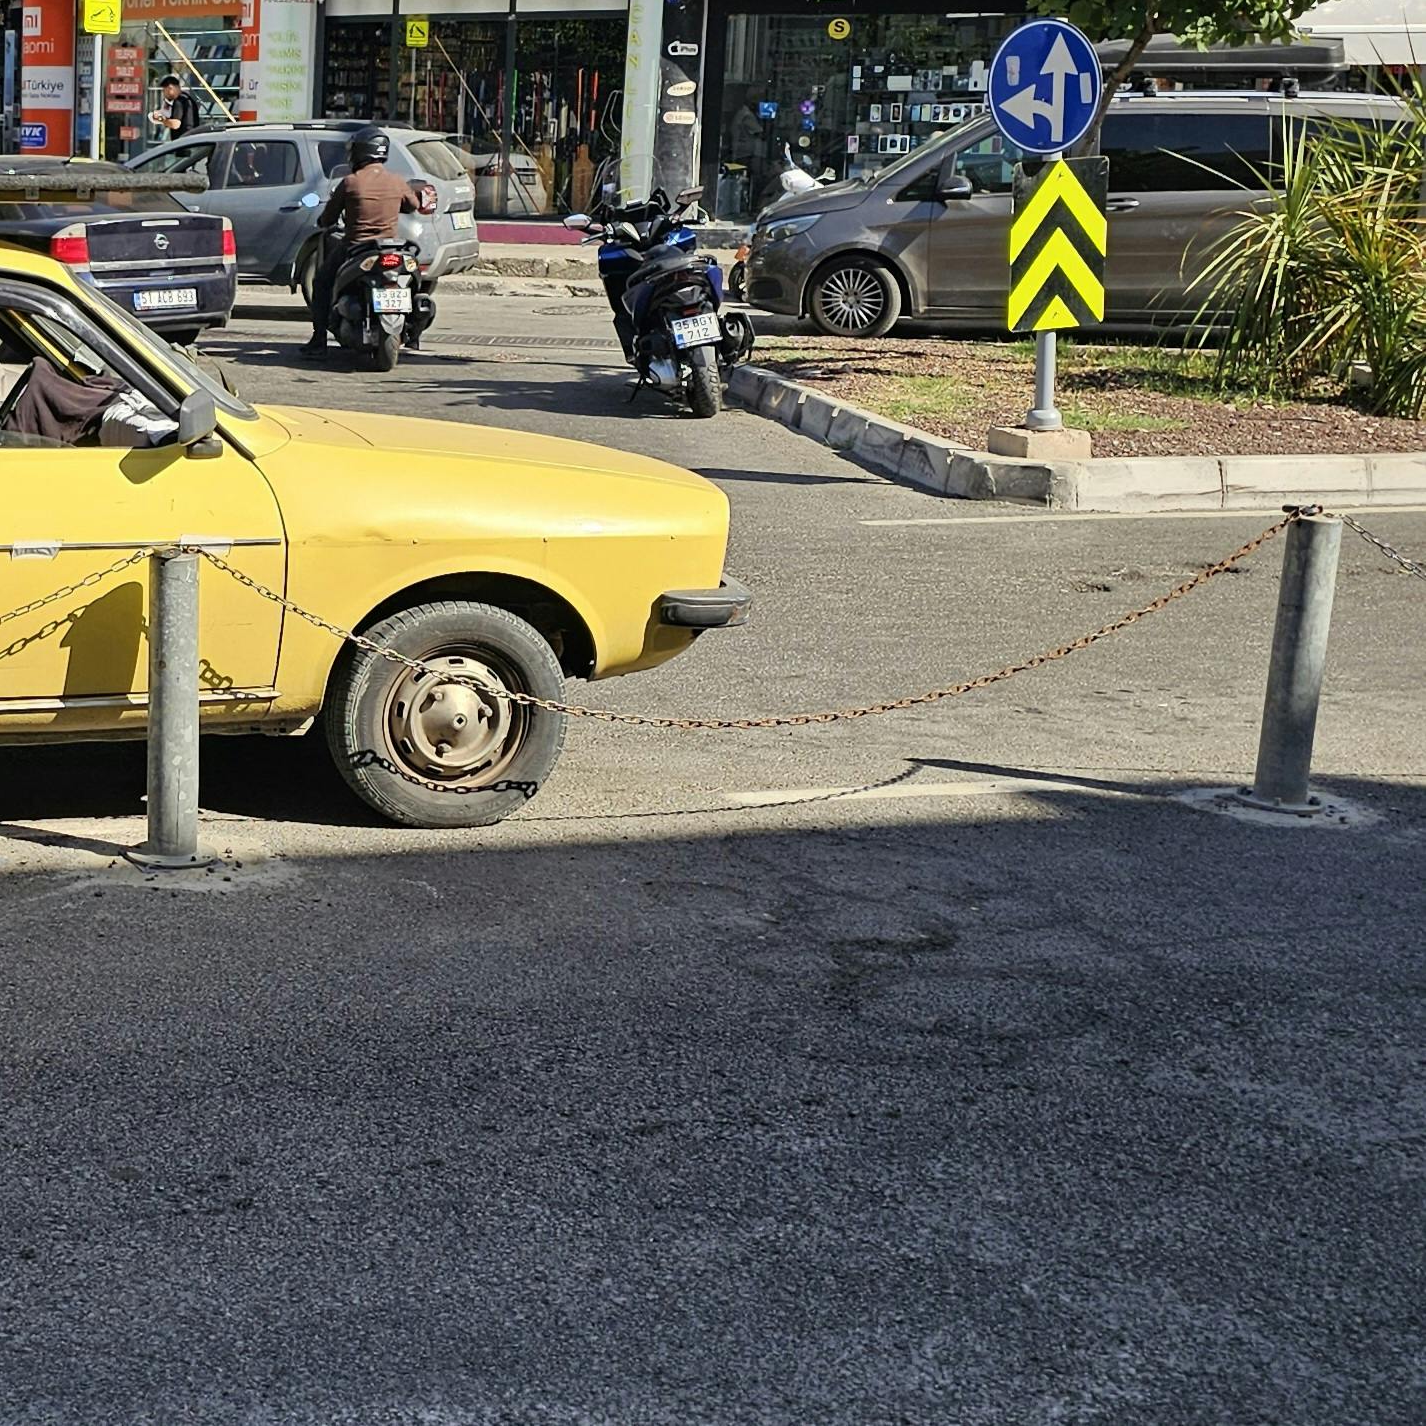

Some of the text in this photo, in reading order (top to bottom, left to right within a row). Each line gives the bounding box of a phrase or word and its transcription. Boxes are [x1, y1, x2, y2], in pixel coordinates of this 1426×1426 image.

[834, 20, 845, 33] S
[675, 320, 690, 331] 35
[687, 328, 711, 340] 712
